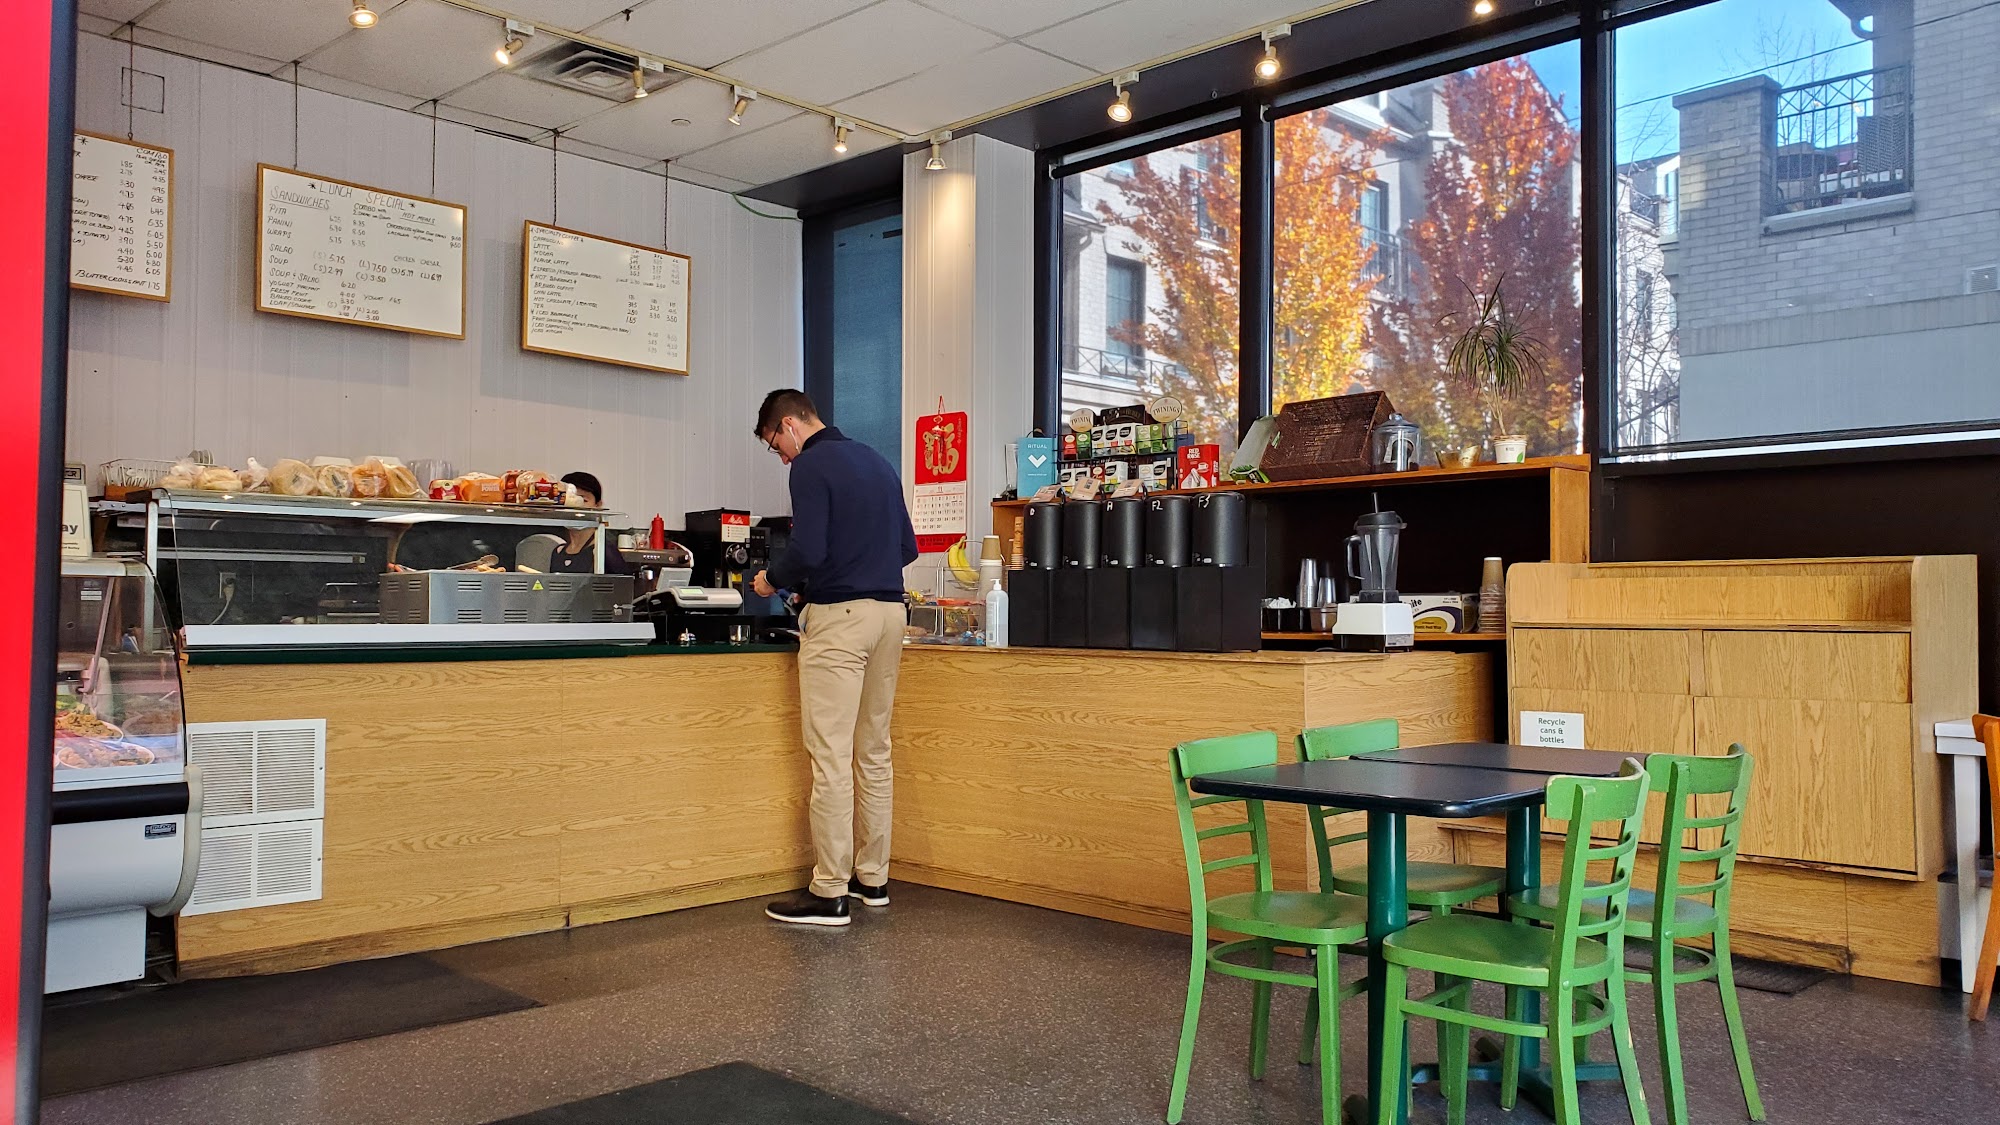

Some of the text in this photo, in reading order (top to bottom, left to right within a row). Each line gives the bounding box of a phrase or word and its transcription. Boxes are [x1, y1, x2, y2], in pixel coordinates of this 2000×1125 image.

[270, 186, 330, 210] SANDWICHES
[320, 182, 405, 210] LUNCH SPECIAL
[269, 204, 286, 215] PITA
[354, 203, 376, 212] COMBO
[402, 212, 415, 220] HOT
[267, 216, 292, 228] PANINI
[267, 228, 292, 238] WRAPS
[269, 243, 294, 254] SALAD
[269, 254, 288, 265] SOUP
[270, 268, 290, 278] SOUP
[298, 272, 320, 284] SALAD
[1153, 405, 1180, 416] TWININGS
[1152, 500, 1163, 511] F2
[1198, 494, 1211, 508] F3
[1538, 718, 1566, 726] Recycle
[1540, 736, 1564, 744] bottles
